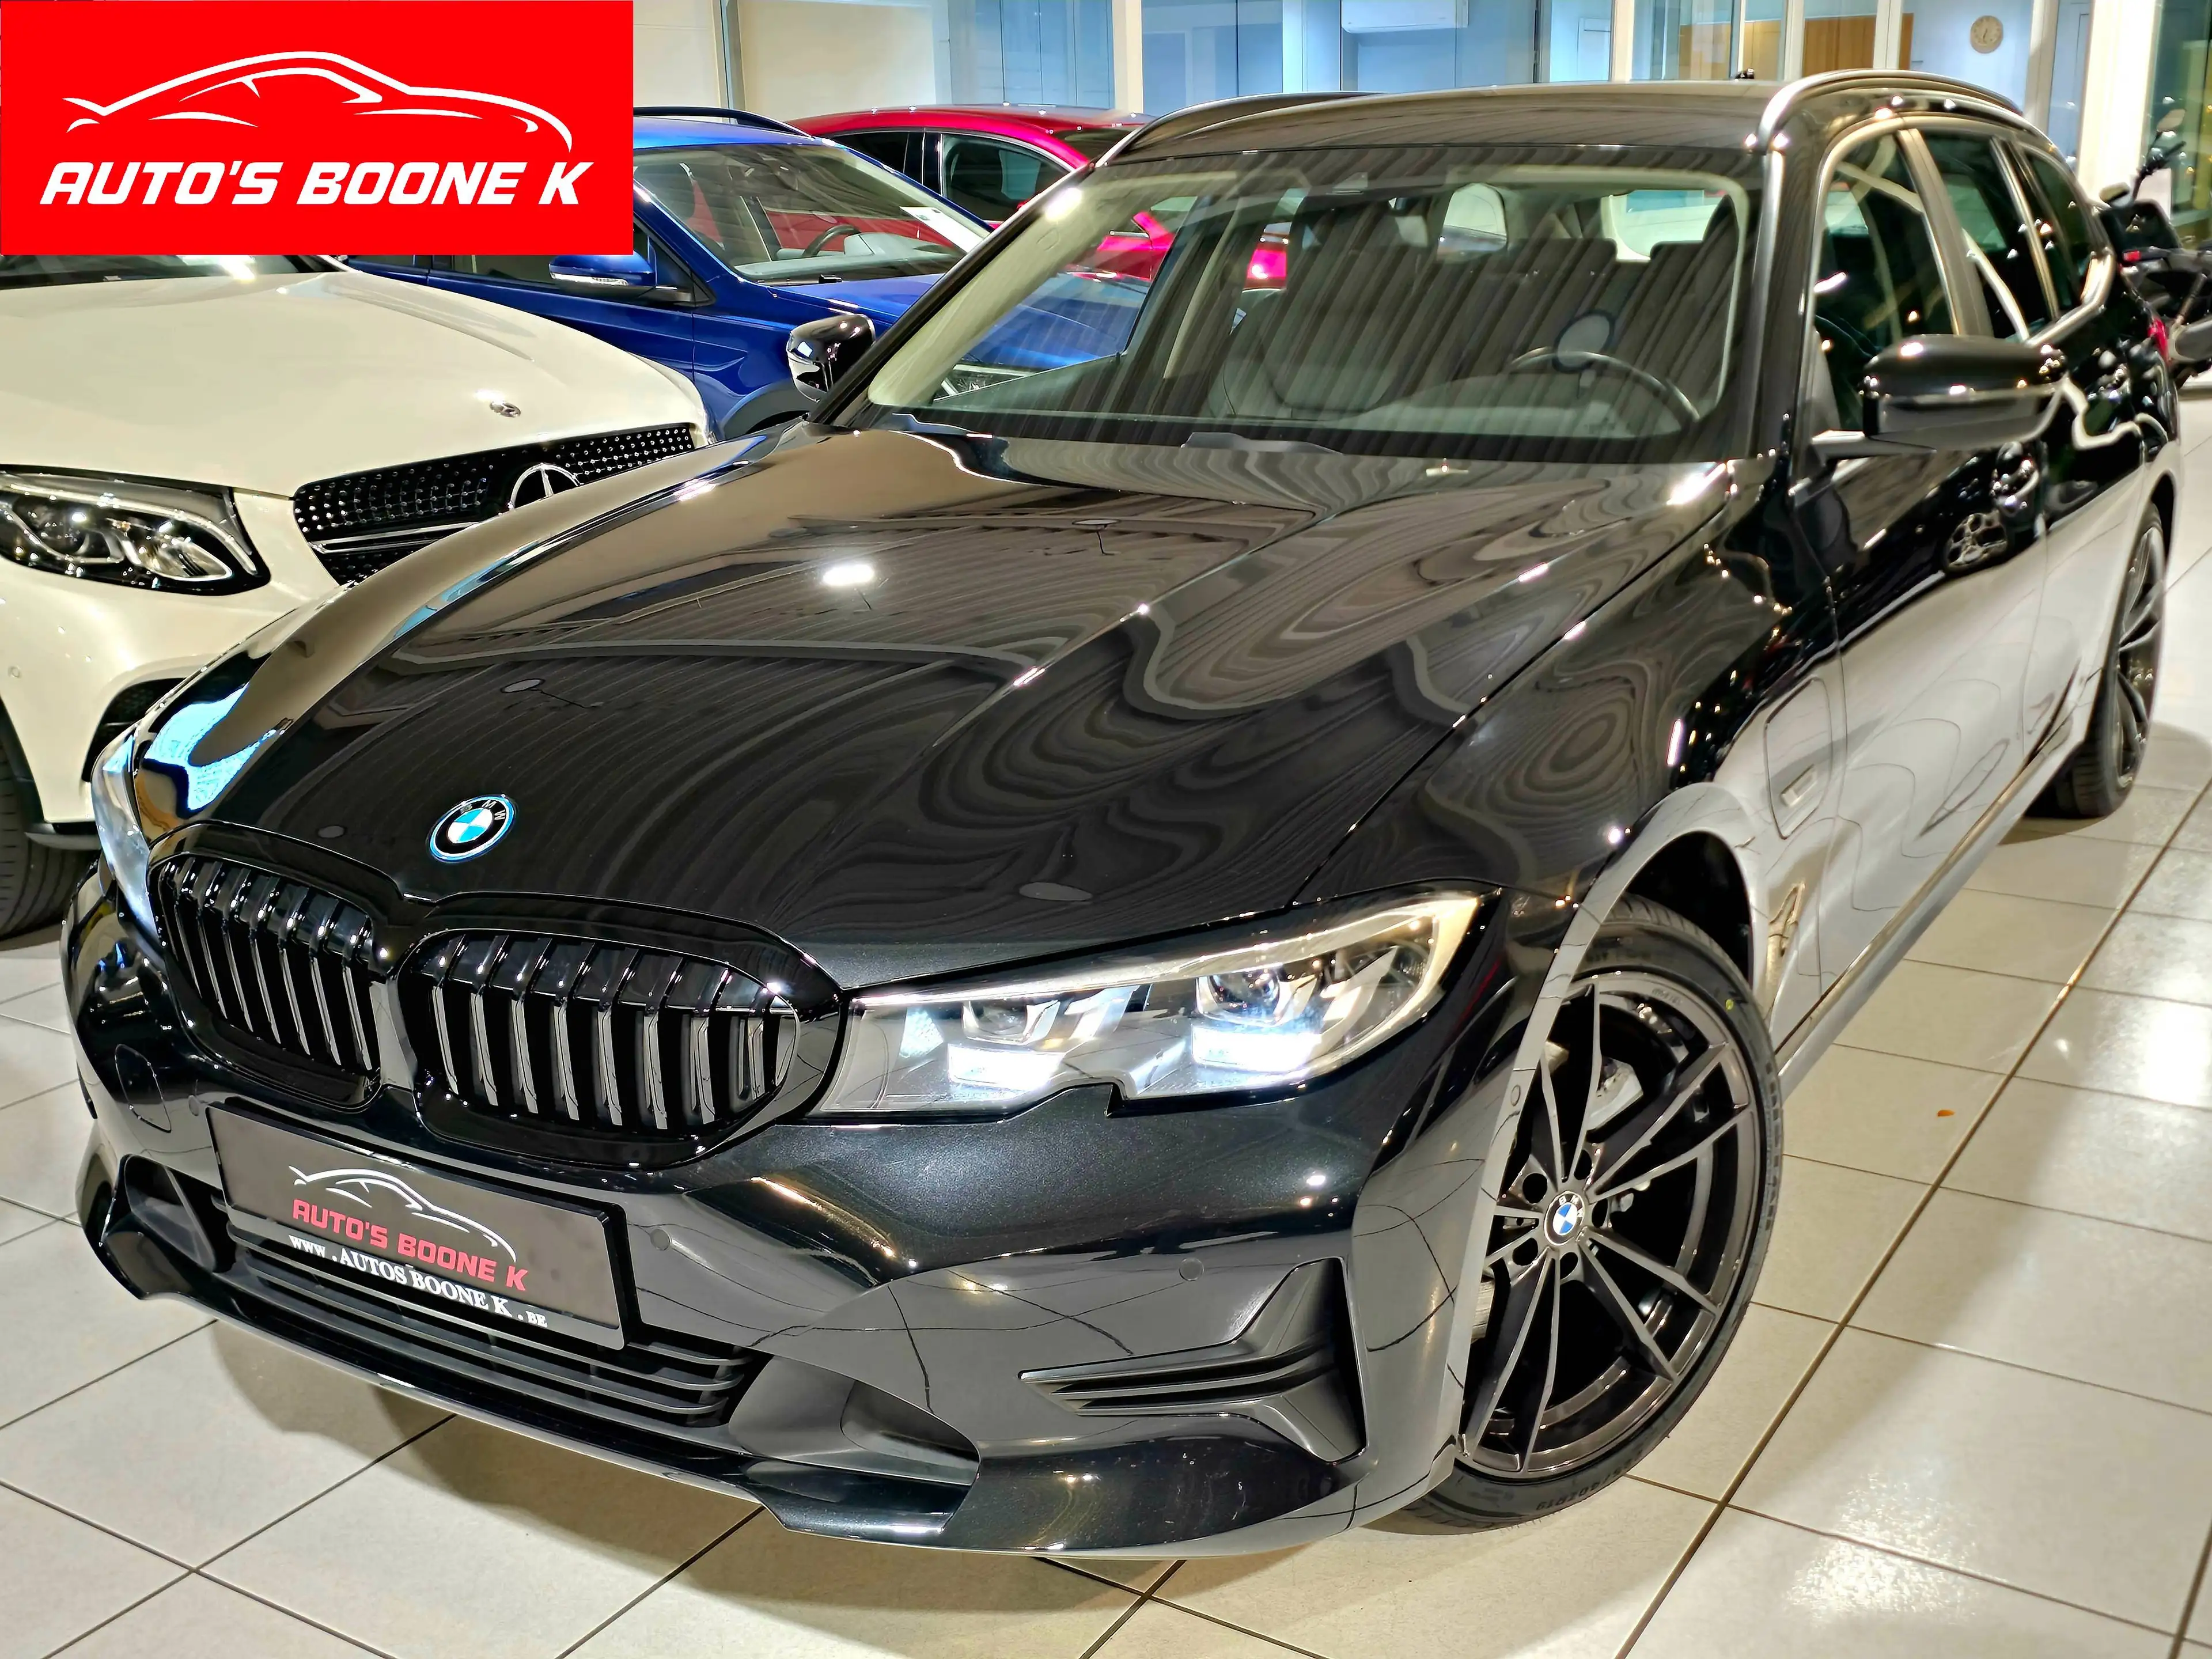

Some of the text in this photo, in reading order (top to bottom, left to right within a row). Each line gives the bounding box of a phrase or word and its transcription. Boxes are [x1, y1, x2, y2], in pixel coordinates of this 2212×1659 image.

[292, 1198, 529, 1291] AUTO'S BOONE K
[409, 1270, 489, 1310] BOONE
[490, 1294, 513, 1318] K
